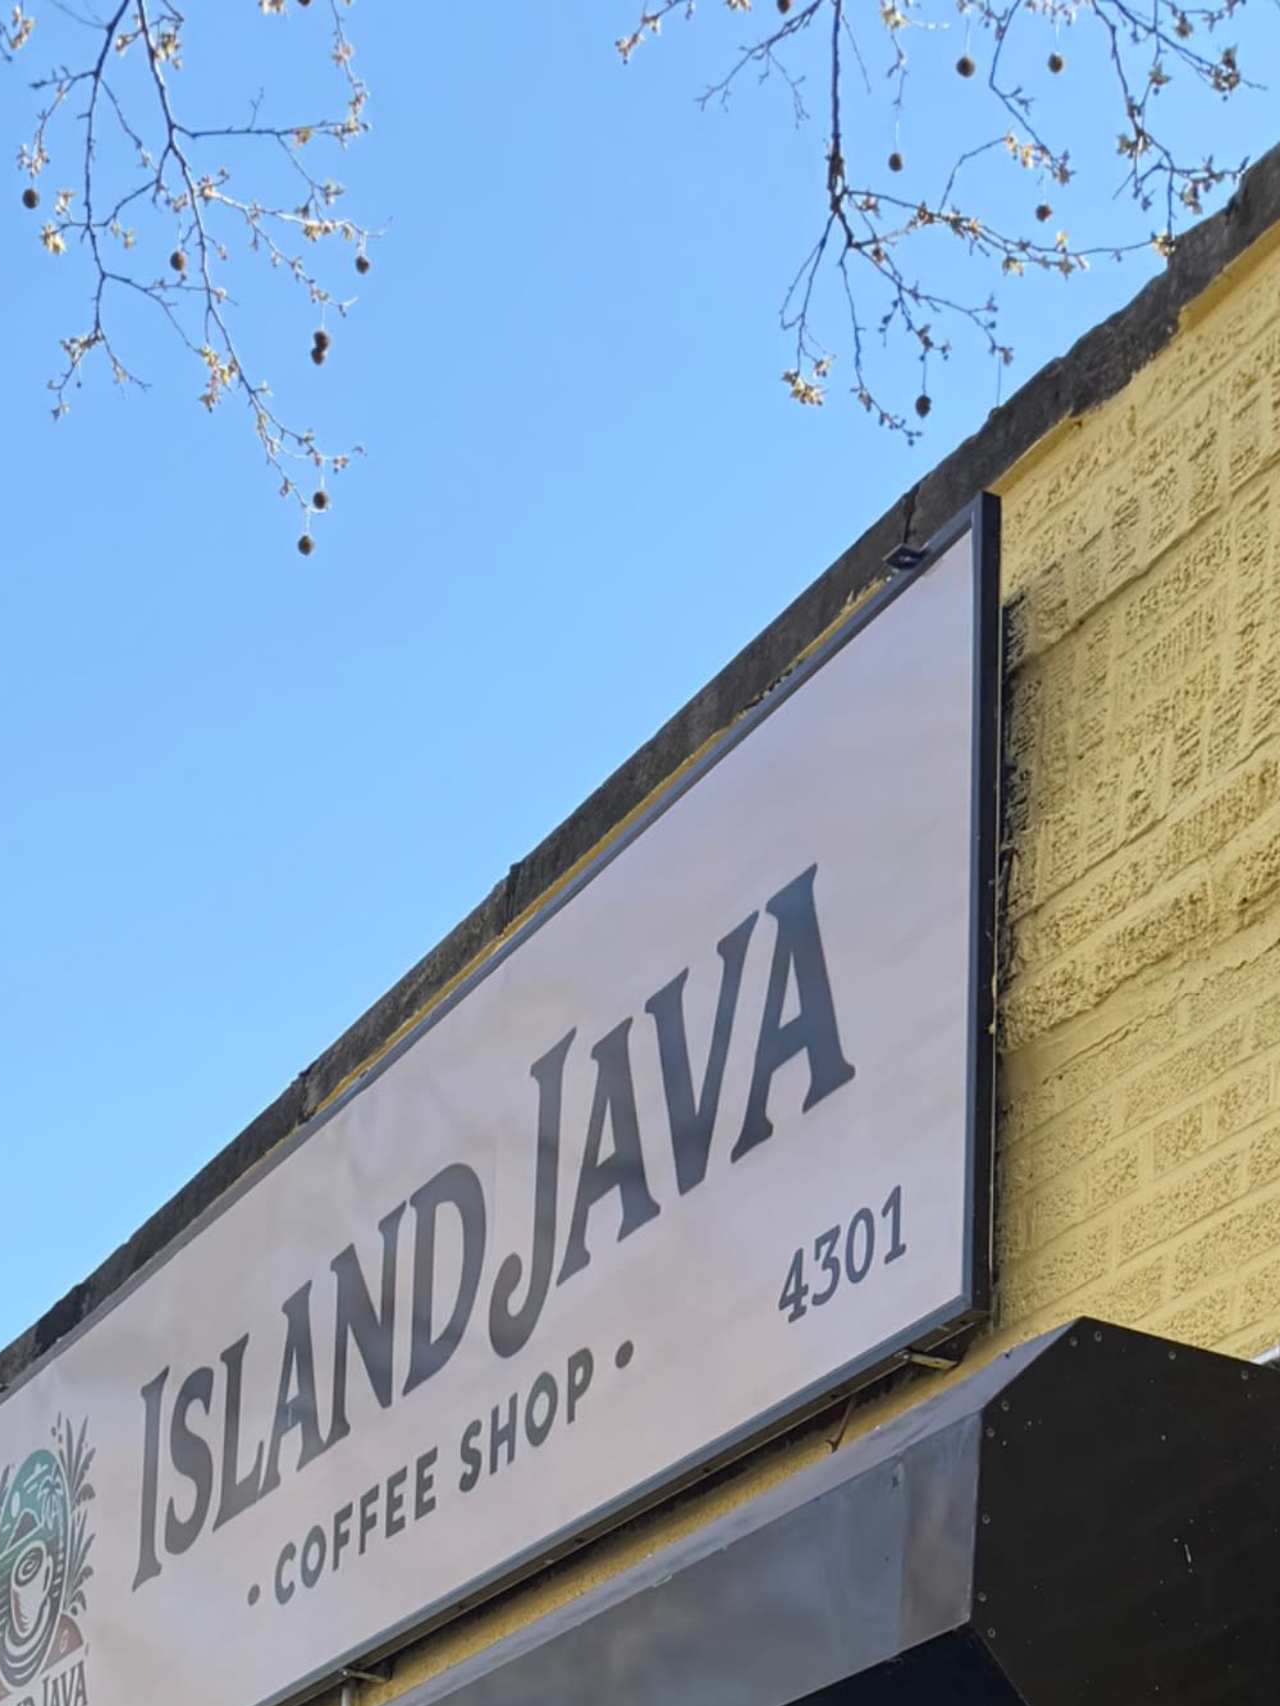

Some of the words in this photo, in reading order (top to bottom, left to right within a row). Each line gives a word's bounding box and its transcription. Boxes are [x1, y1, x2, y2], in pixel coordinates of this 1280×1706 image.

[489, 862, 856, 1359] JAVA
[778, 1184, 908, 1325] 4301
[274, 1445, 438, 1606] COFFEE
[460, 1346, 595, 1493] SHOP
